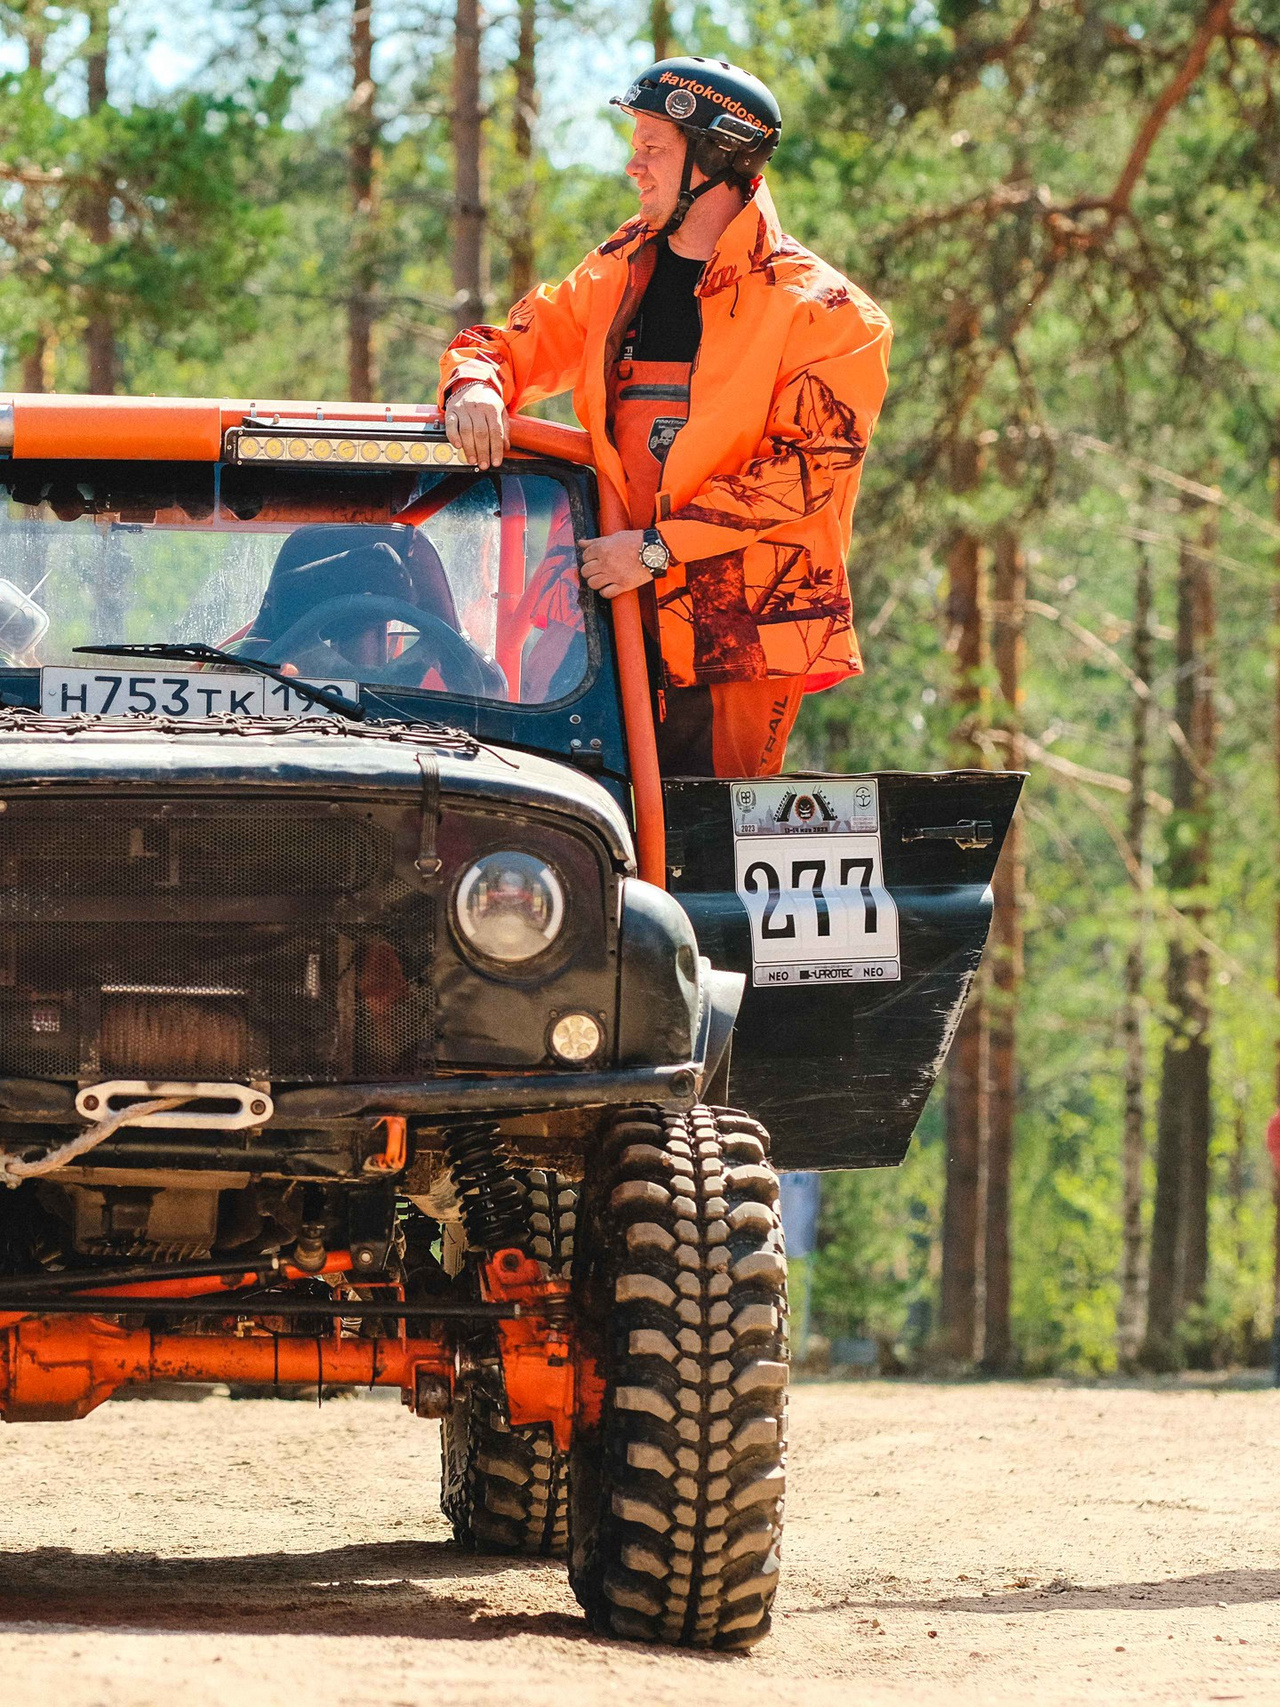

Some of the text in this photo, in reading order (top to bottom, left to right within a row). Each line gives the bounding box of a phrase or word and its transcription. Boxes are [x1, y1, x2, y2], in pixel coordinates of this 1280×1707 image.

[744, 858, 878, 939] 277
[769, 967, 884, 981] NEO SUPROTEC NEO
